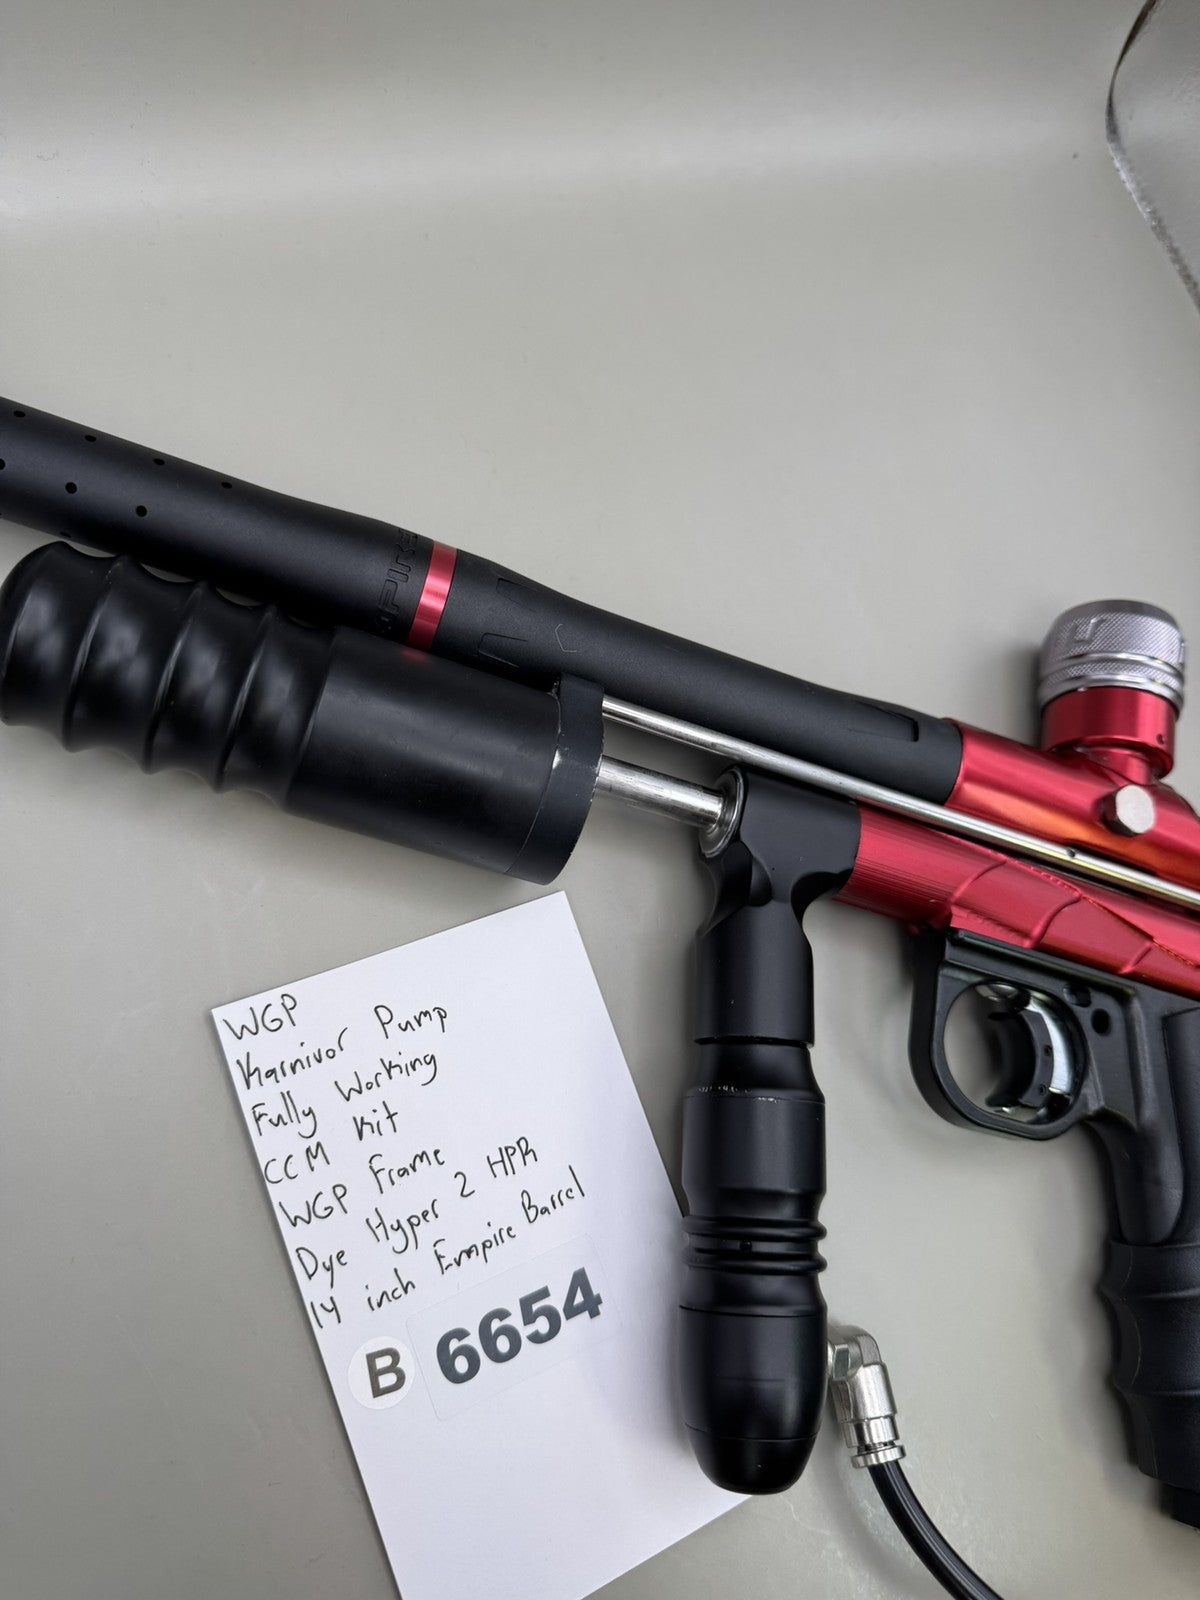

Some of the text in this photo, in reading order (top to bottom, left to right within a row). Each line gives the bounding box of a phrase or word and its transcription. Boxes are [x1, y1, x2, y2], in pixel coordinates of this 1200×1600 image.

[223, 992, 298, 1041] WGP
[236, 1004, 448, 1091] Karnivor Pump
[251, 1051, 438, 1140] Fully Working
[264, 1140, 331, 1185] CCM
[278, 1148, 446, 1228] WGP Frame
[294, 1135, 539, 1290] Dye Hyper 2 HPR
[310, 1164, 586, 1330] 14 inch Empire Barrel
[365, 1266, 604, 1399] B 6654
